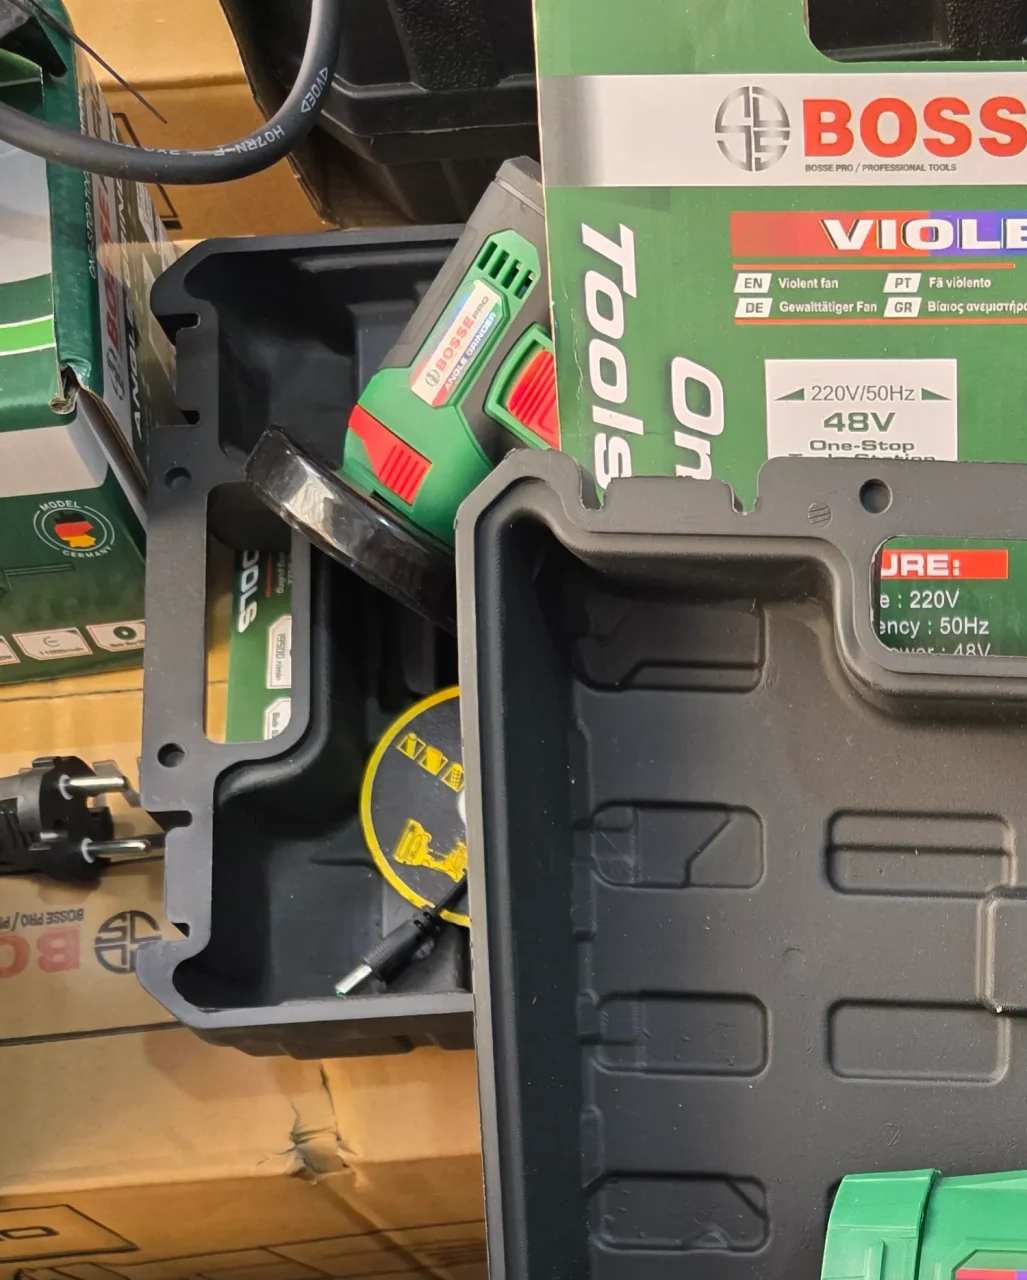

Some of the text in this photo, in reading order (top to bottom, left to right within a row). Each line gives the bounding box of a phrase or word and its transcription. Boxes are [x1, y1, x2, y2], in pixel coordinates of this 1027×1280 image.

[805, 164, 833, 172] BOSSE
[836, 164, 853, 172] PRO
[862, 164, 926, 172] PROFESSIONAL
[929, 163, 957, 172] TOOLS
[744, 277, 838, 289] EN Violent fan
[894, 277, 911, 289] PT
[745, 301, 877, 314] DE Gewalttätiger Fan
[894, 302, 912, 313] GR
[436, 296, 489, 371] BOSSE PRO
[444, 312, 497, 390] ANGLE GRINDER
[581, 222, 644, 490] Tools
[811, 385, 916, 402] 220V/50Hz
[823, 412, 896, 433] 48V
[809, 440, 915, 452] One-Stop
[39, 500, 82, 512] MODEL
[62, 545, 112, 559] GERMANY
[909, 588, 960, 609] 220V
[940, 616, 989, 635] 50Hz
[45, 908, 84, 926] BOSSE
